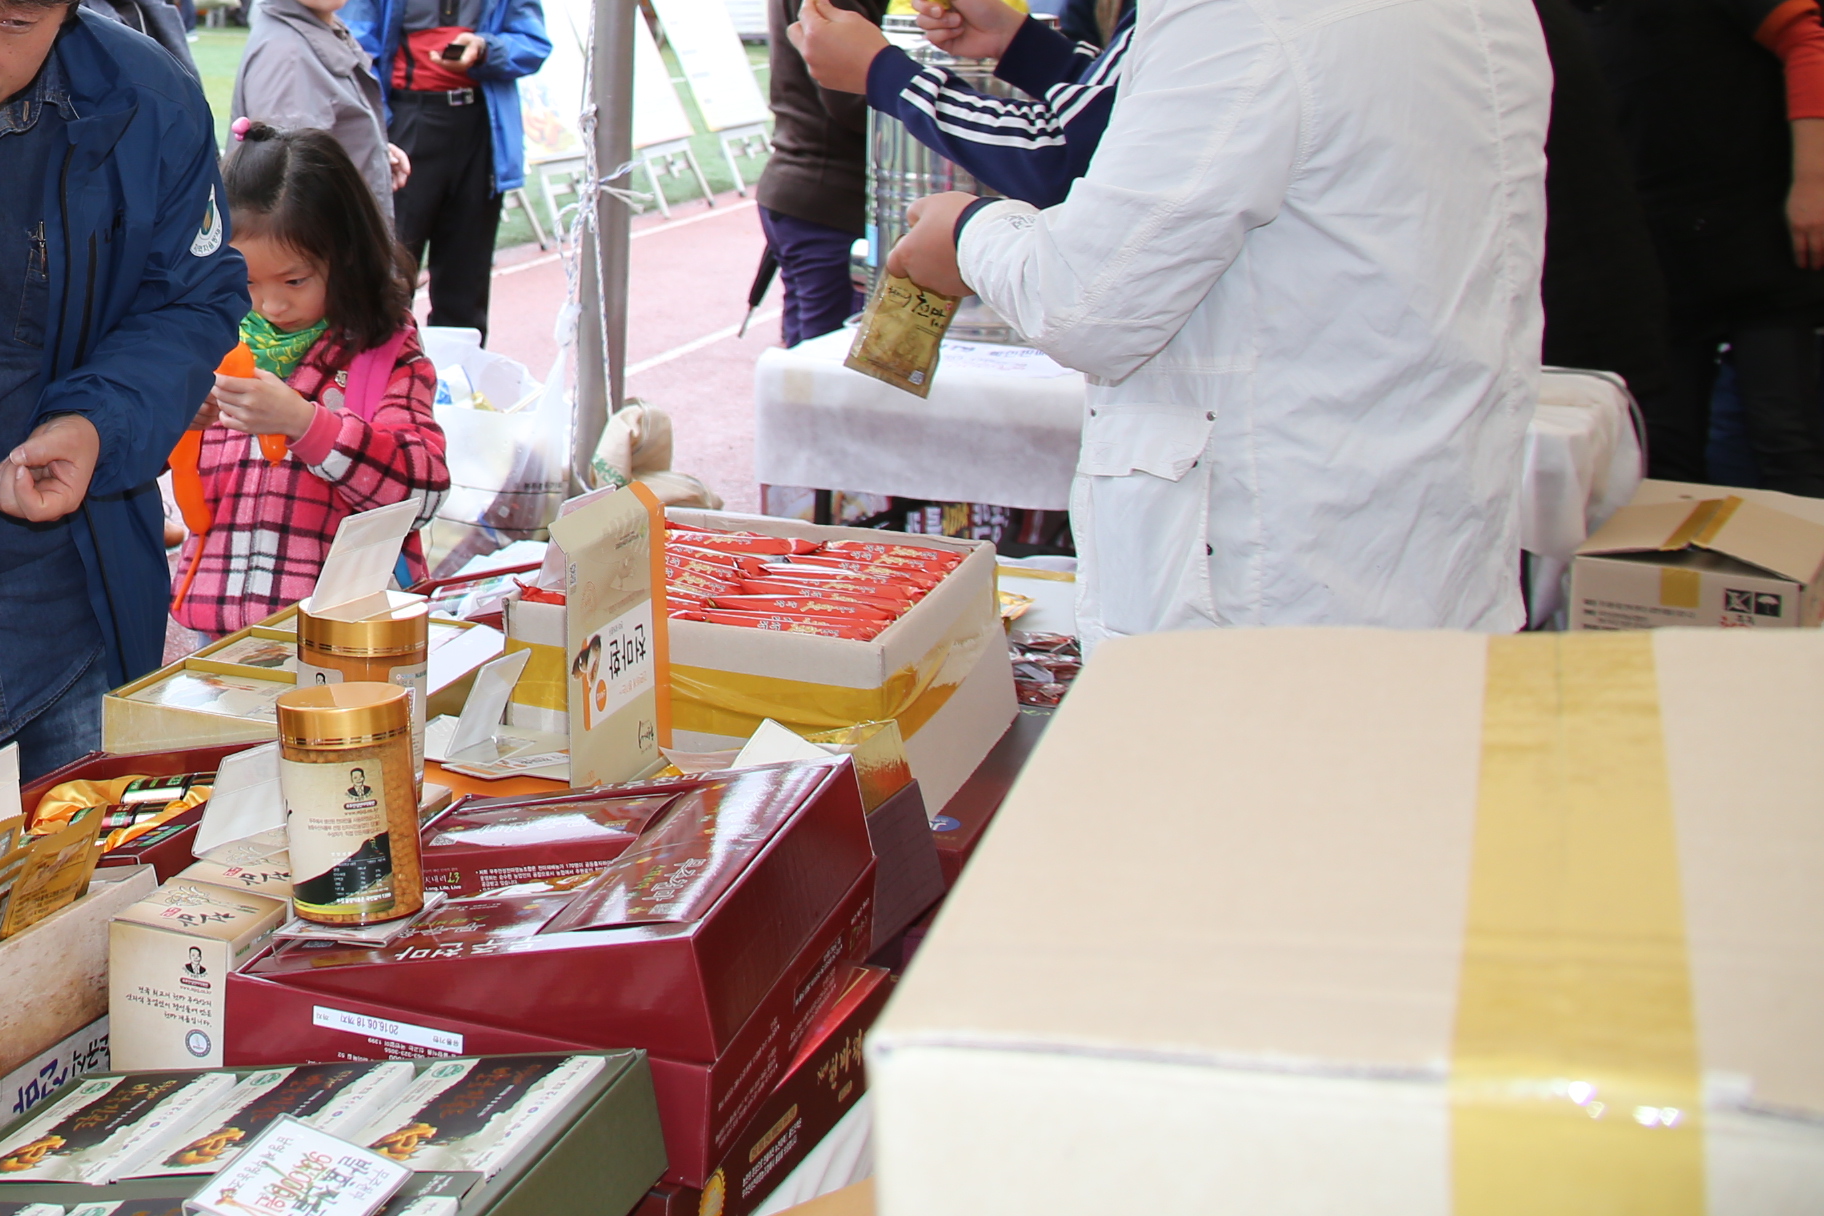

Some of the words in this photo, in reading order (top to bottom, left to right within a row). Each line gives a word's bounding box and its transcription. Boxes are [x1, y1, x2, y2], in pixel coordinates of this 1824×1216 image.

[609, 624, 646, 680] 천마환
[340, 1013, 355, 1025] 까지
[356, 1016, 399, 1035] 2016.06.18
[367, 1037, 381, 1046] 1399
[432, 1035, 459, 1048] 유통기한
